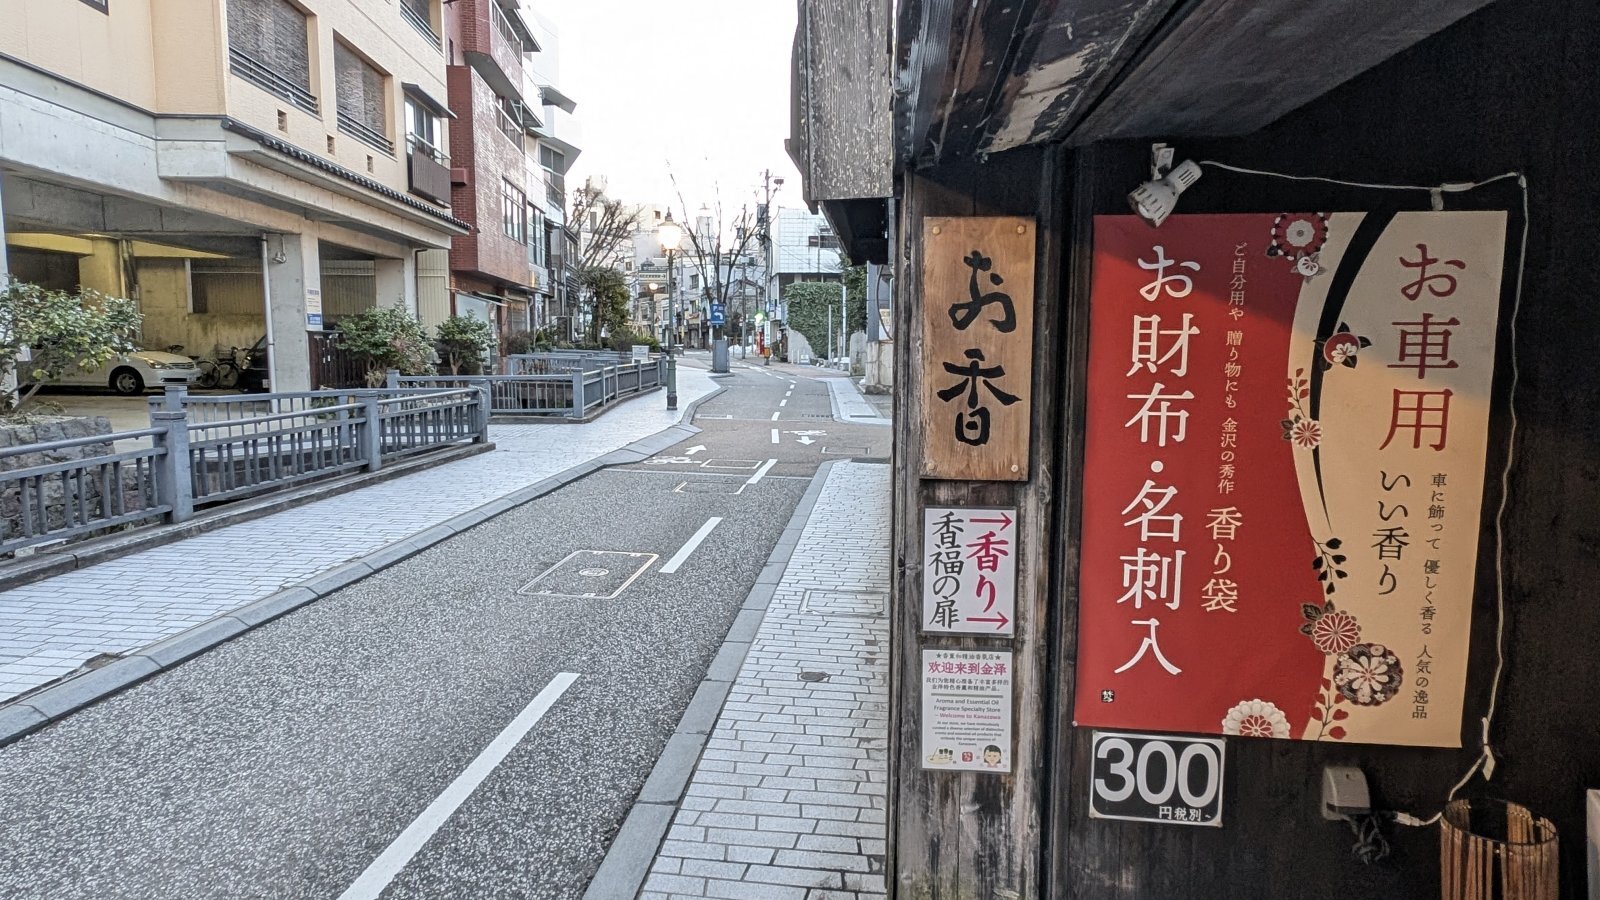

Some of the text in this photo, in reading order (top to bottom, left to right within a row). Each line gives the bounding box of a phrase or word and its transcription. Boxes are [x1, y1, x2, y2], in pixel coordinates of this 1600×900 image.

[936, 249, 1023, 446] お香
[1201, 242, 1248, 613] ご自分用や 贈り物にも 金沢の秀作 香り袋
[1371, 243, 1466, 596] お車用 いい香り
[1114, 245, 1201, 675] お財布・名刺入
[928, 511, 964, 630] 香福の扉
[928, 661, 1007, 676] 欢迎来到金泽
[965, 531, 1009, 613] 香り
[1411, 472, 1447, 719] 車に飾って 優しく香る 人気の逸品
[1094, 737, 1219, 808] 300
